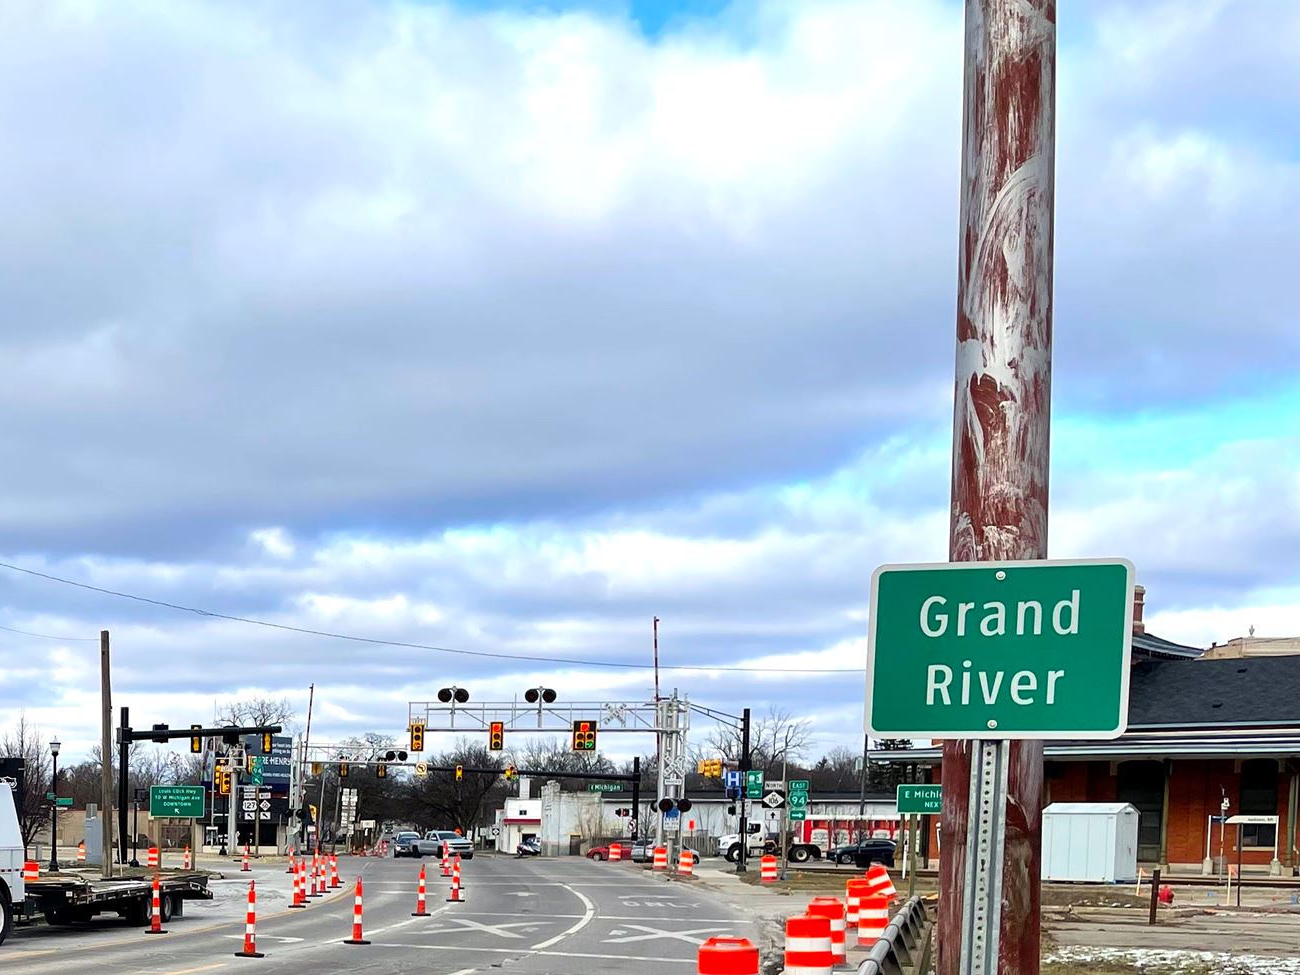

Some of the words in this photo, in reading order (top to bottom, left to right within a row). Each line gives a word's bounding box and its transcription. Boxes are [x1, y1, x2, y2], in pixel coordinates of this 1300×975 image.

[919, 590, 1080, 638] Grand
[926, 660, 1065, 705] River
[728, 772, 739, 786] H
[792, 796, 804, 804] 94
